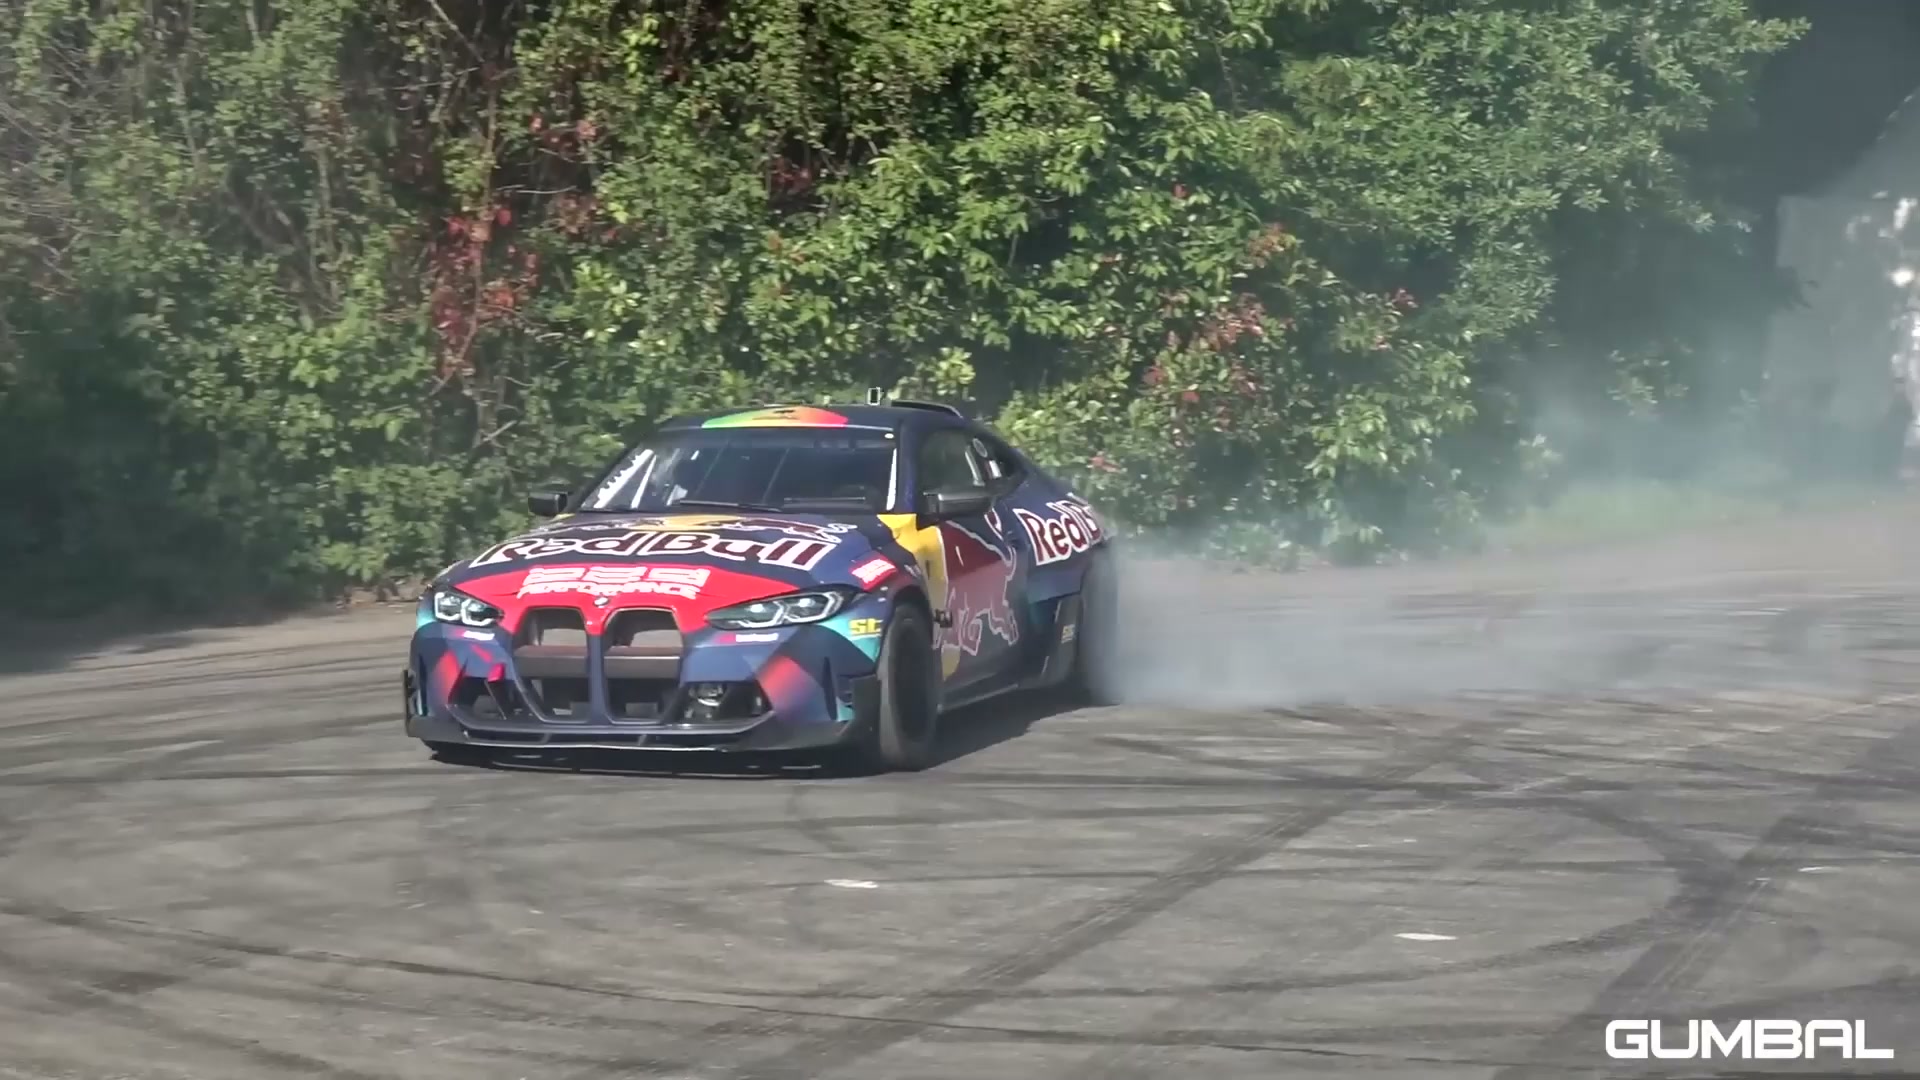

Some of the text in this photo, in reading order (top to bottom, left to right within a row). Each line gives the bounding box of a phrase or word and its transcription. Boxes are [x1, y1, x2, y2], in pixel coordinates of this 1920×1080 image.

[469, 531, 838, 571] Red Bull
[1013, 500, 1090, 566] Red
